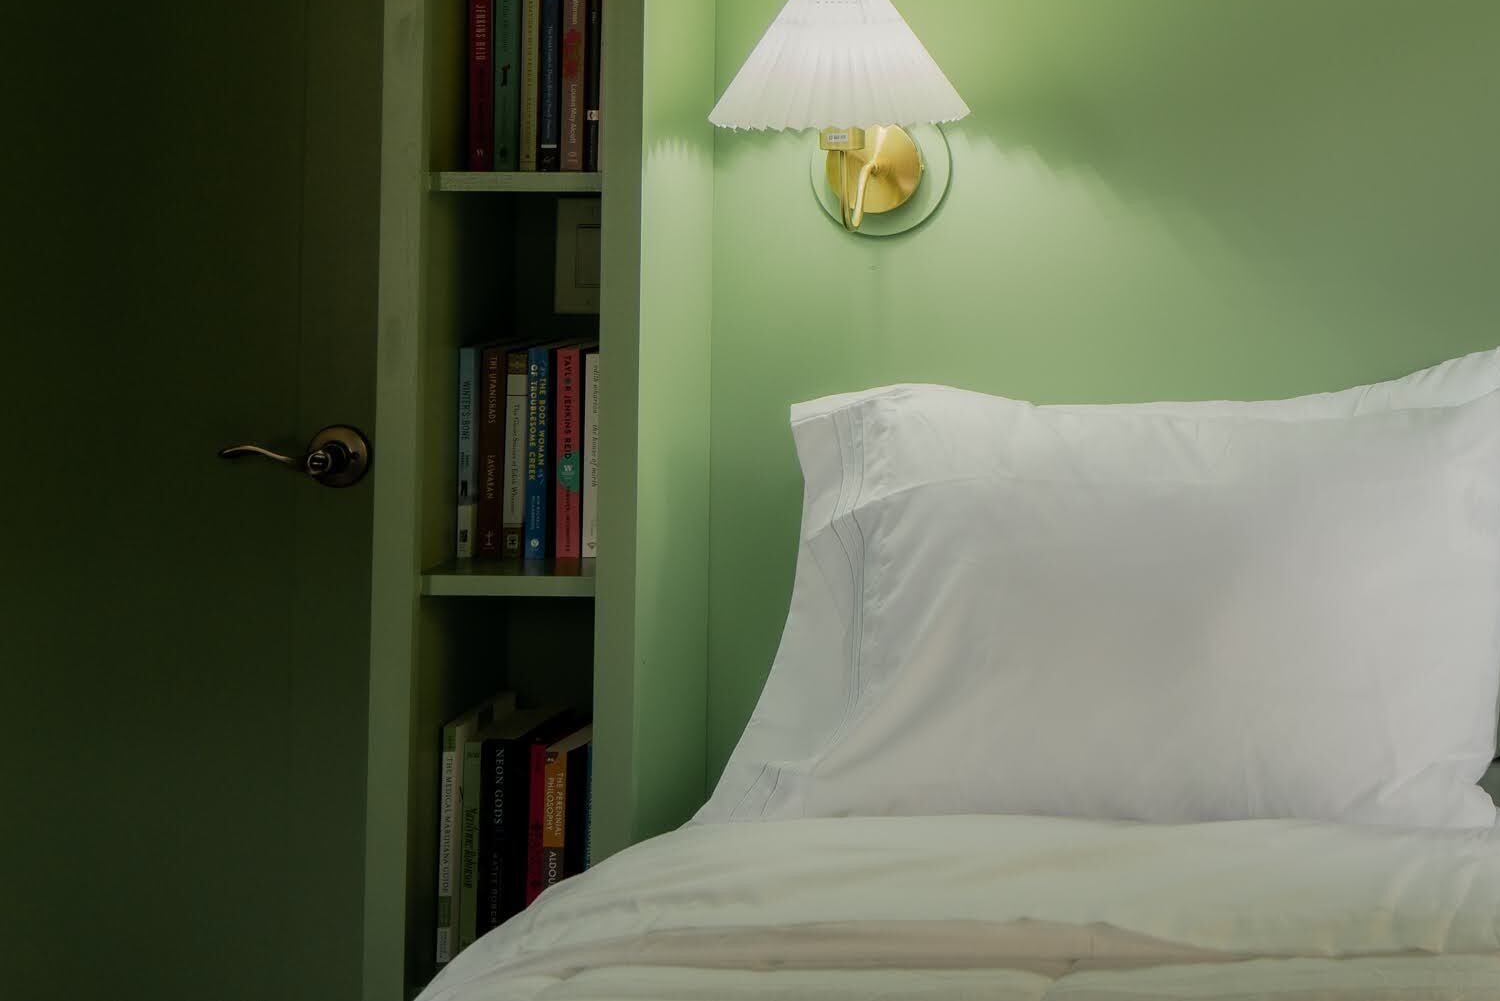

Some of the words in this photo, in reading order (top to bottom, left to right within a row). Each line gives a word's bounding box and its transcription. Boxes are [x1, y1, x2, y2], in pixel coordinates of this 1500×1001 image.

[530, 365, 537, 377] OF
[463, 381, 471, 417] WINTER'S
[529, 381, 537, 449] TROUBLESOME
[462, 421, 470, 440] BONE
[528, 452, 536, 480] CREEK
[495, 749, 504, 784] NEON
[494, 790, 503, 824] GODS
[555, 791, 563, 836] PERENNIAL
